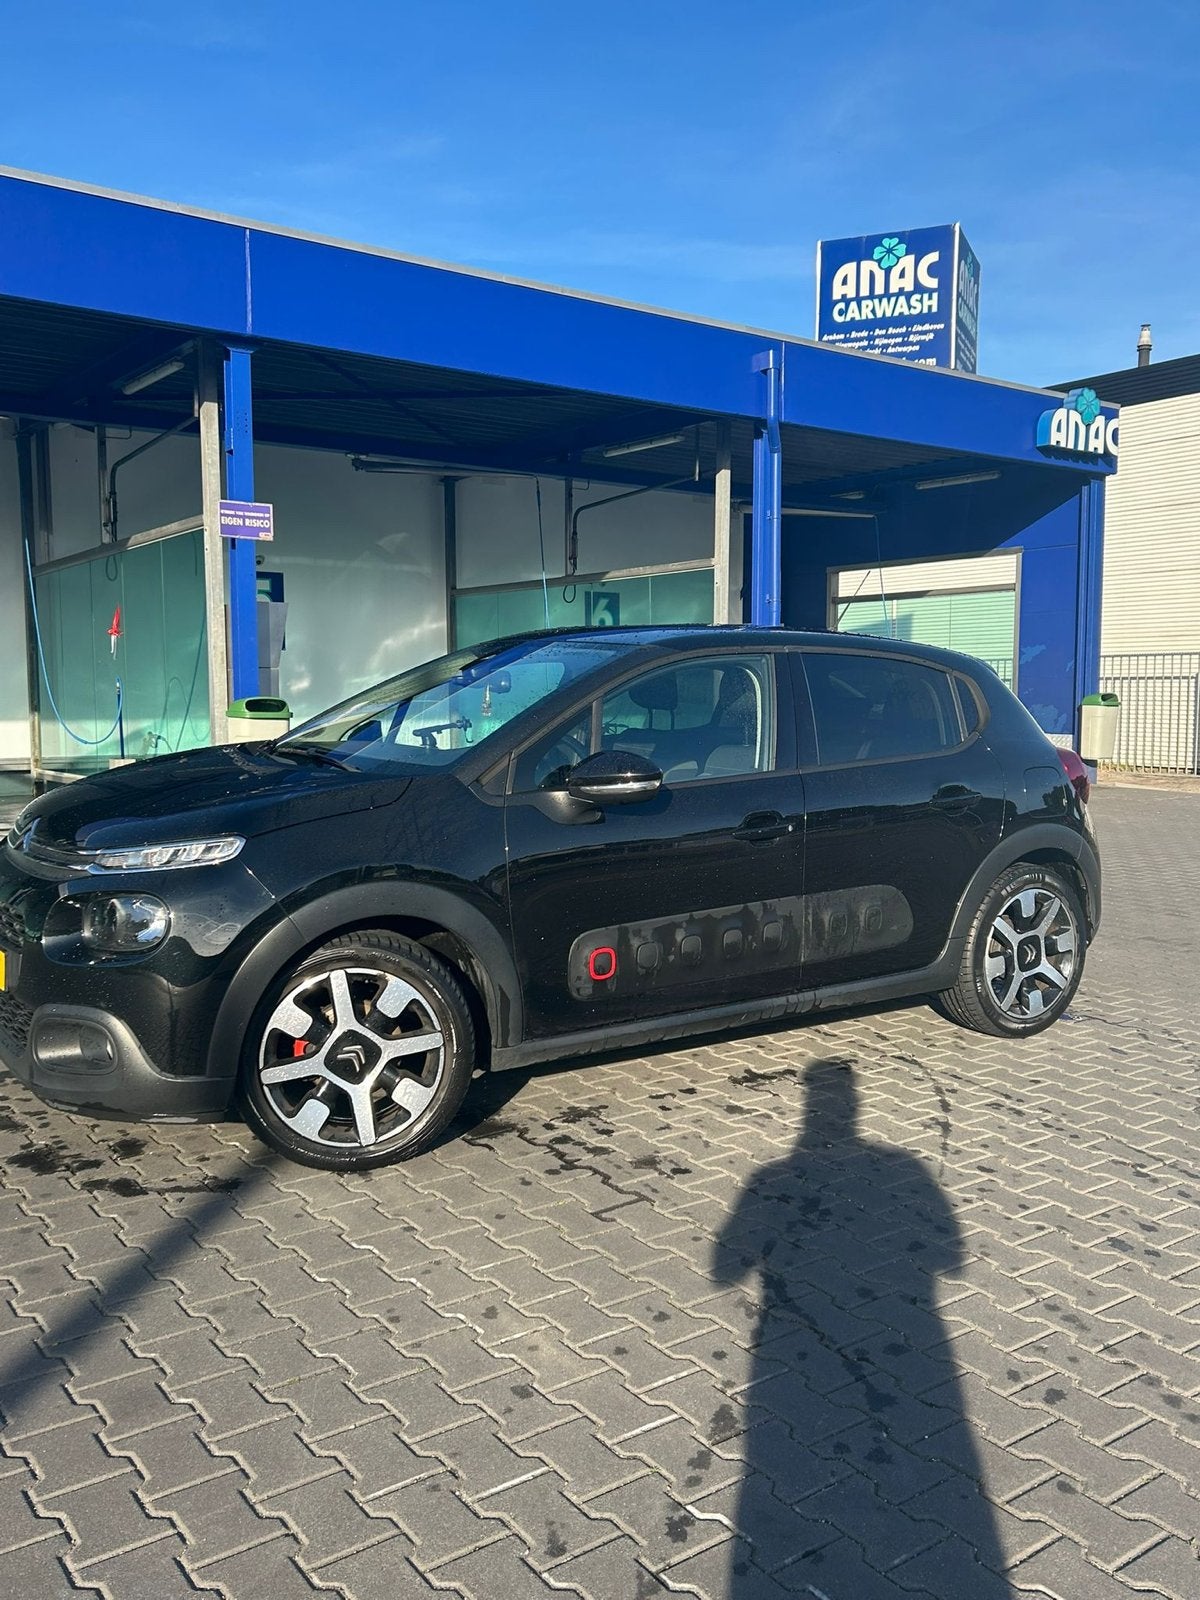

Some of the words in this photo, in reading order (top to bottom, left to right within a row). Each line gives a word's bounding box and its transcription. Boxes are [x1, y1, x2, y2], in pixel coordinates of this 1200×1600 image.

[832, 251, 940, 300] ANAC
[832, 292, 939, 323] CARWASH
[822, 333, 845, 342] Arnhem
[850, 330, 869, 339] Breda
[874, 328, 886, 336] Den
[887, 325, 907, 334] Bosch
[912, 323, 945, 332] Eindhoven
[874, 337, 903, 346] Nijmegen
[1050, 408, 1119, 456] ANAC
[221, 516, 244, 526] EIGEN
[245, 518, 270, 528] RISICO
[592, 597, 613, 626] 6
